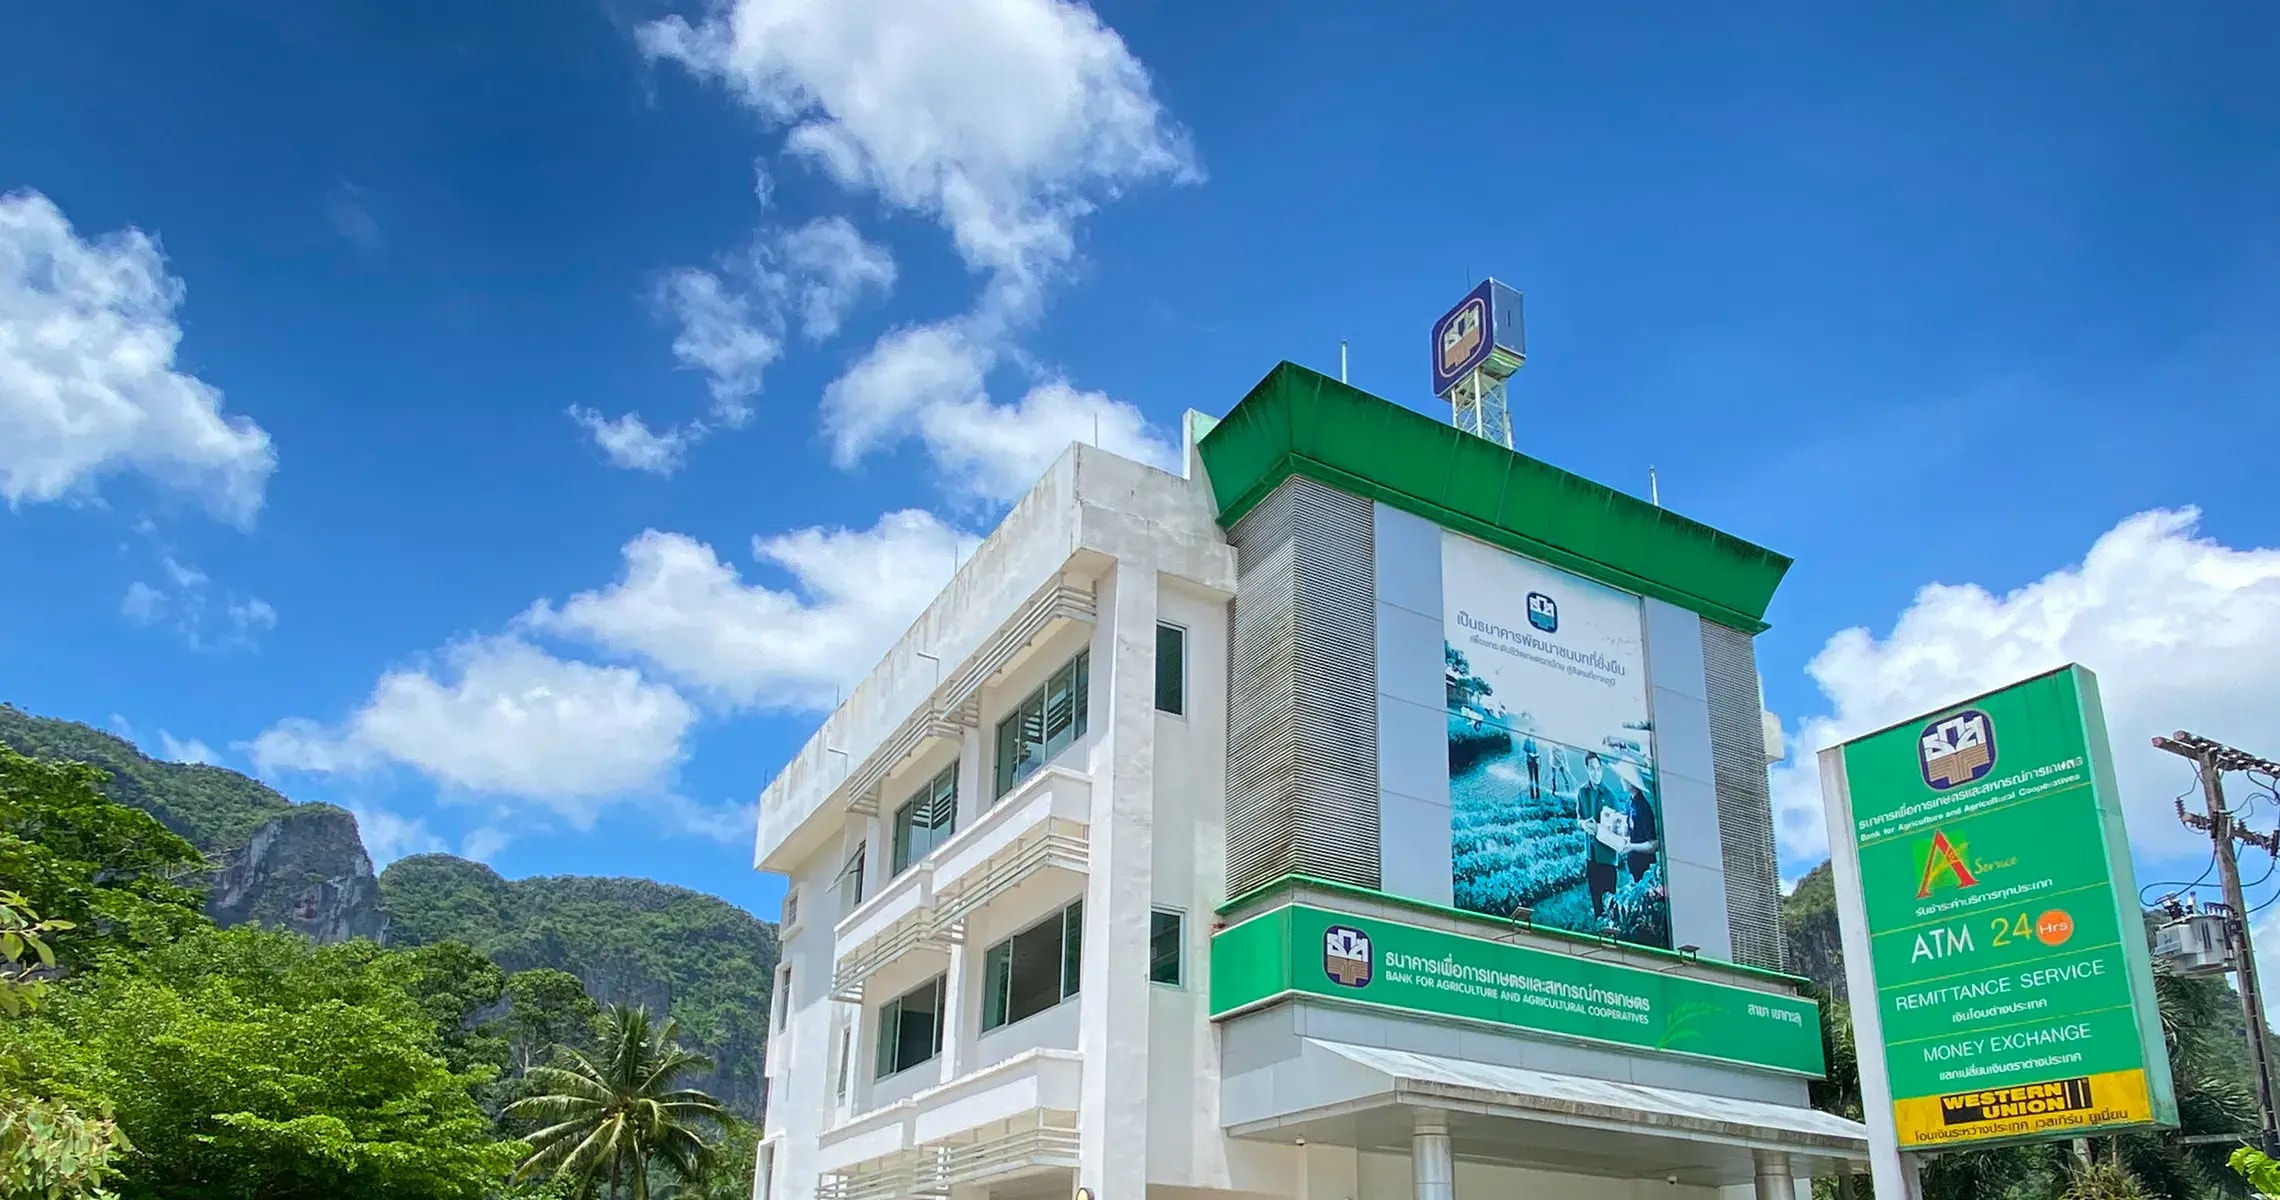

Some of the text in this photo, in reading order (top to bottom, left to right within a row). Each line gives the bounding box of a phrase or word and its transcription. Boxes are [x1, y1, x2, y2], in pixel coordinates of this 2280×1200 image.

[1457, 610, 1626, 676] เป็นธนาคารพัฒนาชนบทที่ยั่งยืน
[1859, 757, 2083, 830] ธนาคารเพื่อการเกษตรและสหกรณ์การเกษตร
[1860, 830, 1881, 842] Bank
[1883, 826, 1895, 837] for
[1898, 813, 1944, 833] Agriculture
[1945, 808, 1962, 819] and
[1964, 791, 2016, 818] Agricultural
[1973, 856, 2017, 875] Service
[1915, 878, 2053, 917] รับชำระค่าบริการทุกประเภท
[1911, 912, 2069, 964] ATM 24 Hrs
[1385, 951, 1651, 1012] ธนาคารเพื่อการเกษตรและสหกรณ์การเกษตร
[1385, 970, 1649, 1025] BANK FOR AGRICULTURE AND AGRICULTURAL COOPERATIVES
[1896, 960, 2106, 1011] REMITTANCE SERVICE
[1952, 998, 2048, 1023] เงินโอนต่างประเทศ
[1924, 1023, 2092, 1063] MONEY EXCHANGE
[1939, 1052, 2082, 1081] แลกเปลี่ยนเงินตราต่างประเทศ
[1942, 1082, 2063, 1111] WESTERN
[1982, 1097, 2065, 1119] UNION
[1915, 1120, 2029, 1142] โอนเงินระหว่างประเทศ
